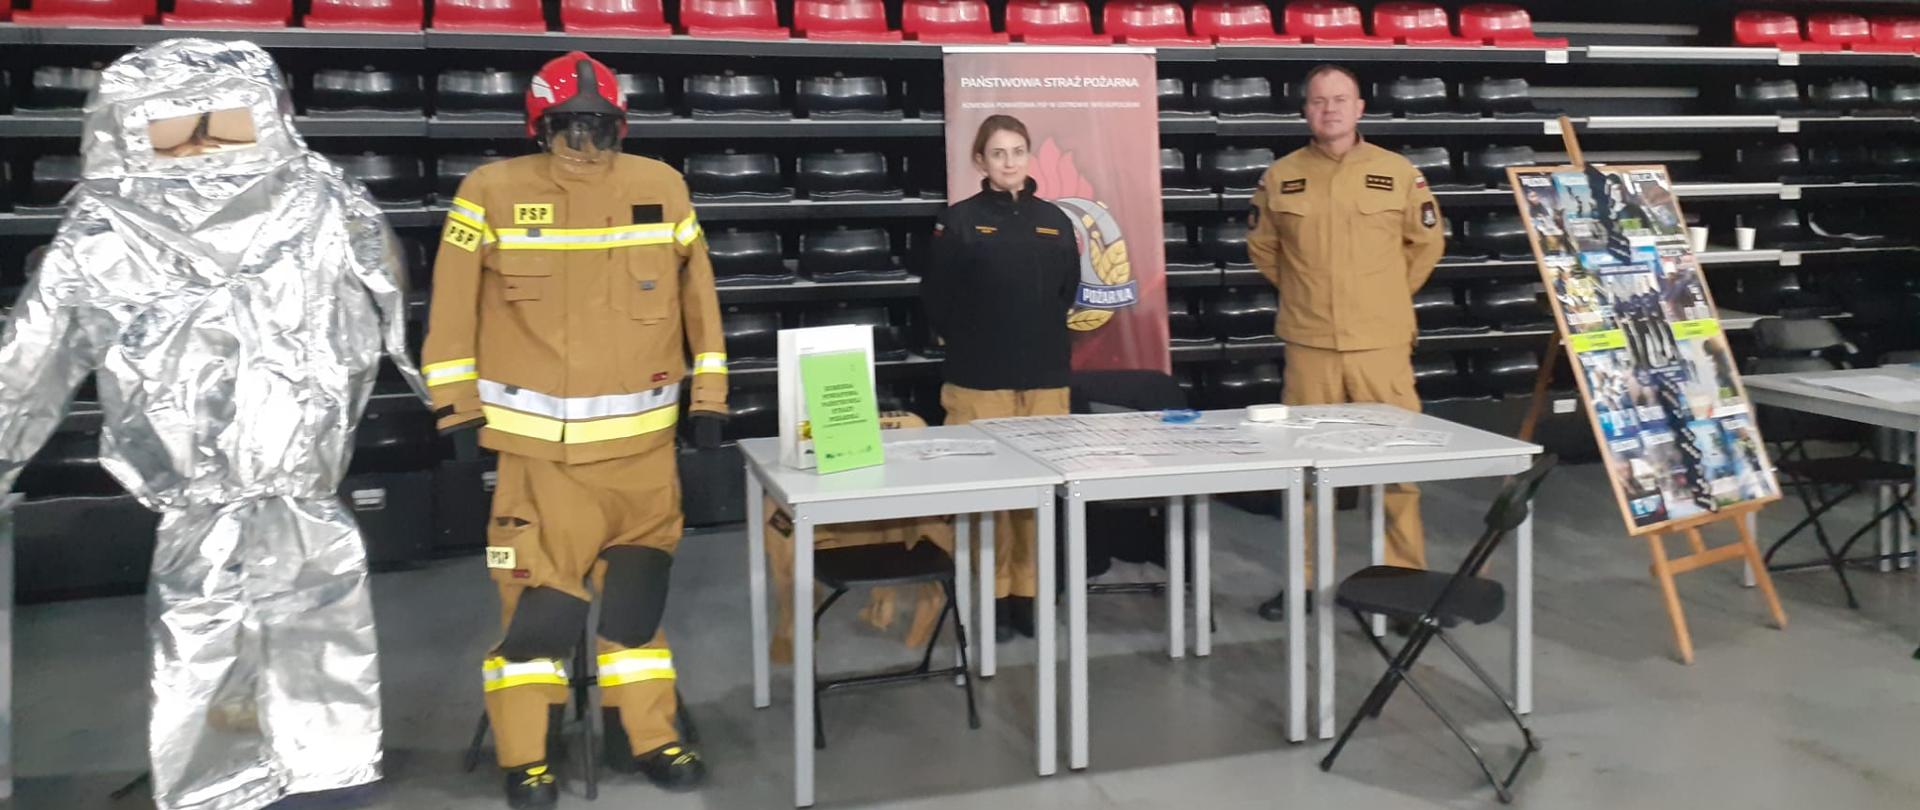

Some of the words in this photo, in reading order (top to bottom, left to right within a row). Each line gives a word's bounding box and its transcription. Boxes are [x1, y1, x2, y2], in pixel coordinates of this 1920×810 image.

[960, 75, 1042, 88] PAŃSTWOWA
[1043, 75, 1082, 88] STRAŻ
[1083, 75, 1139, 88] POŻARNA
[519, 207, 548, 221] PSP
[449, 226, 475, 245] PSP
[1082, 287, 1134, 304] POŻARNA
